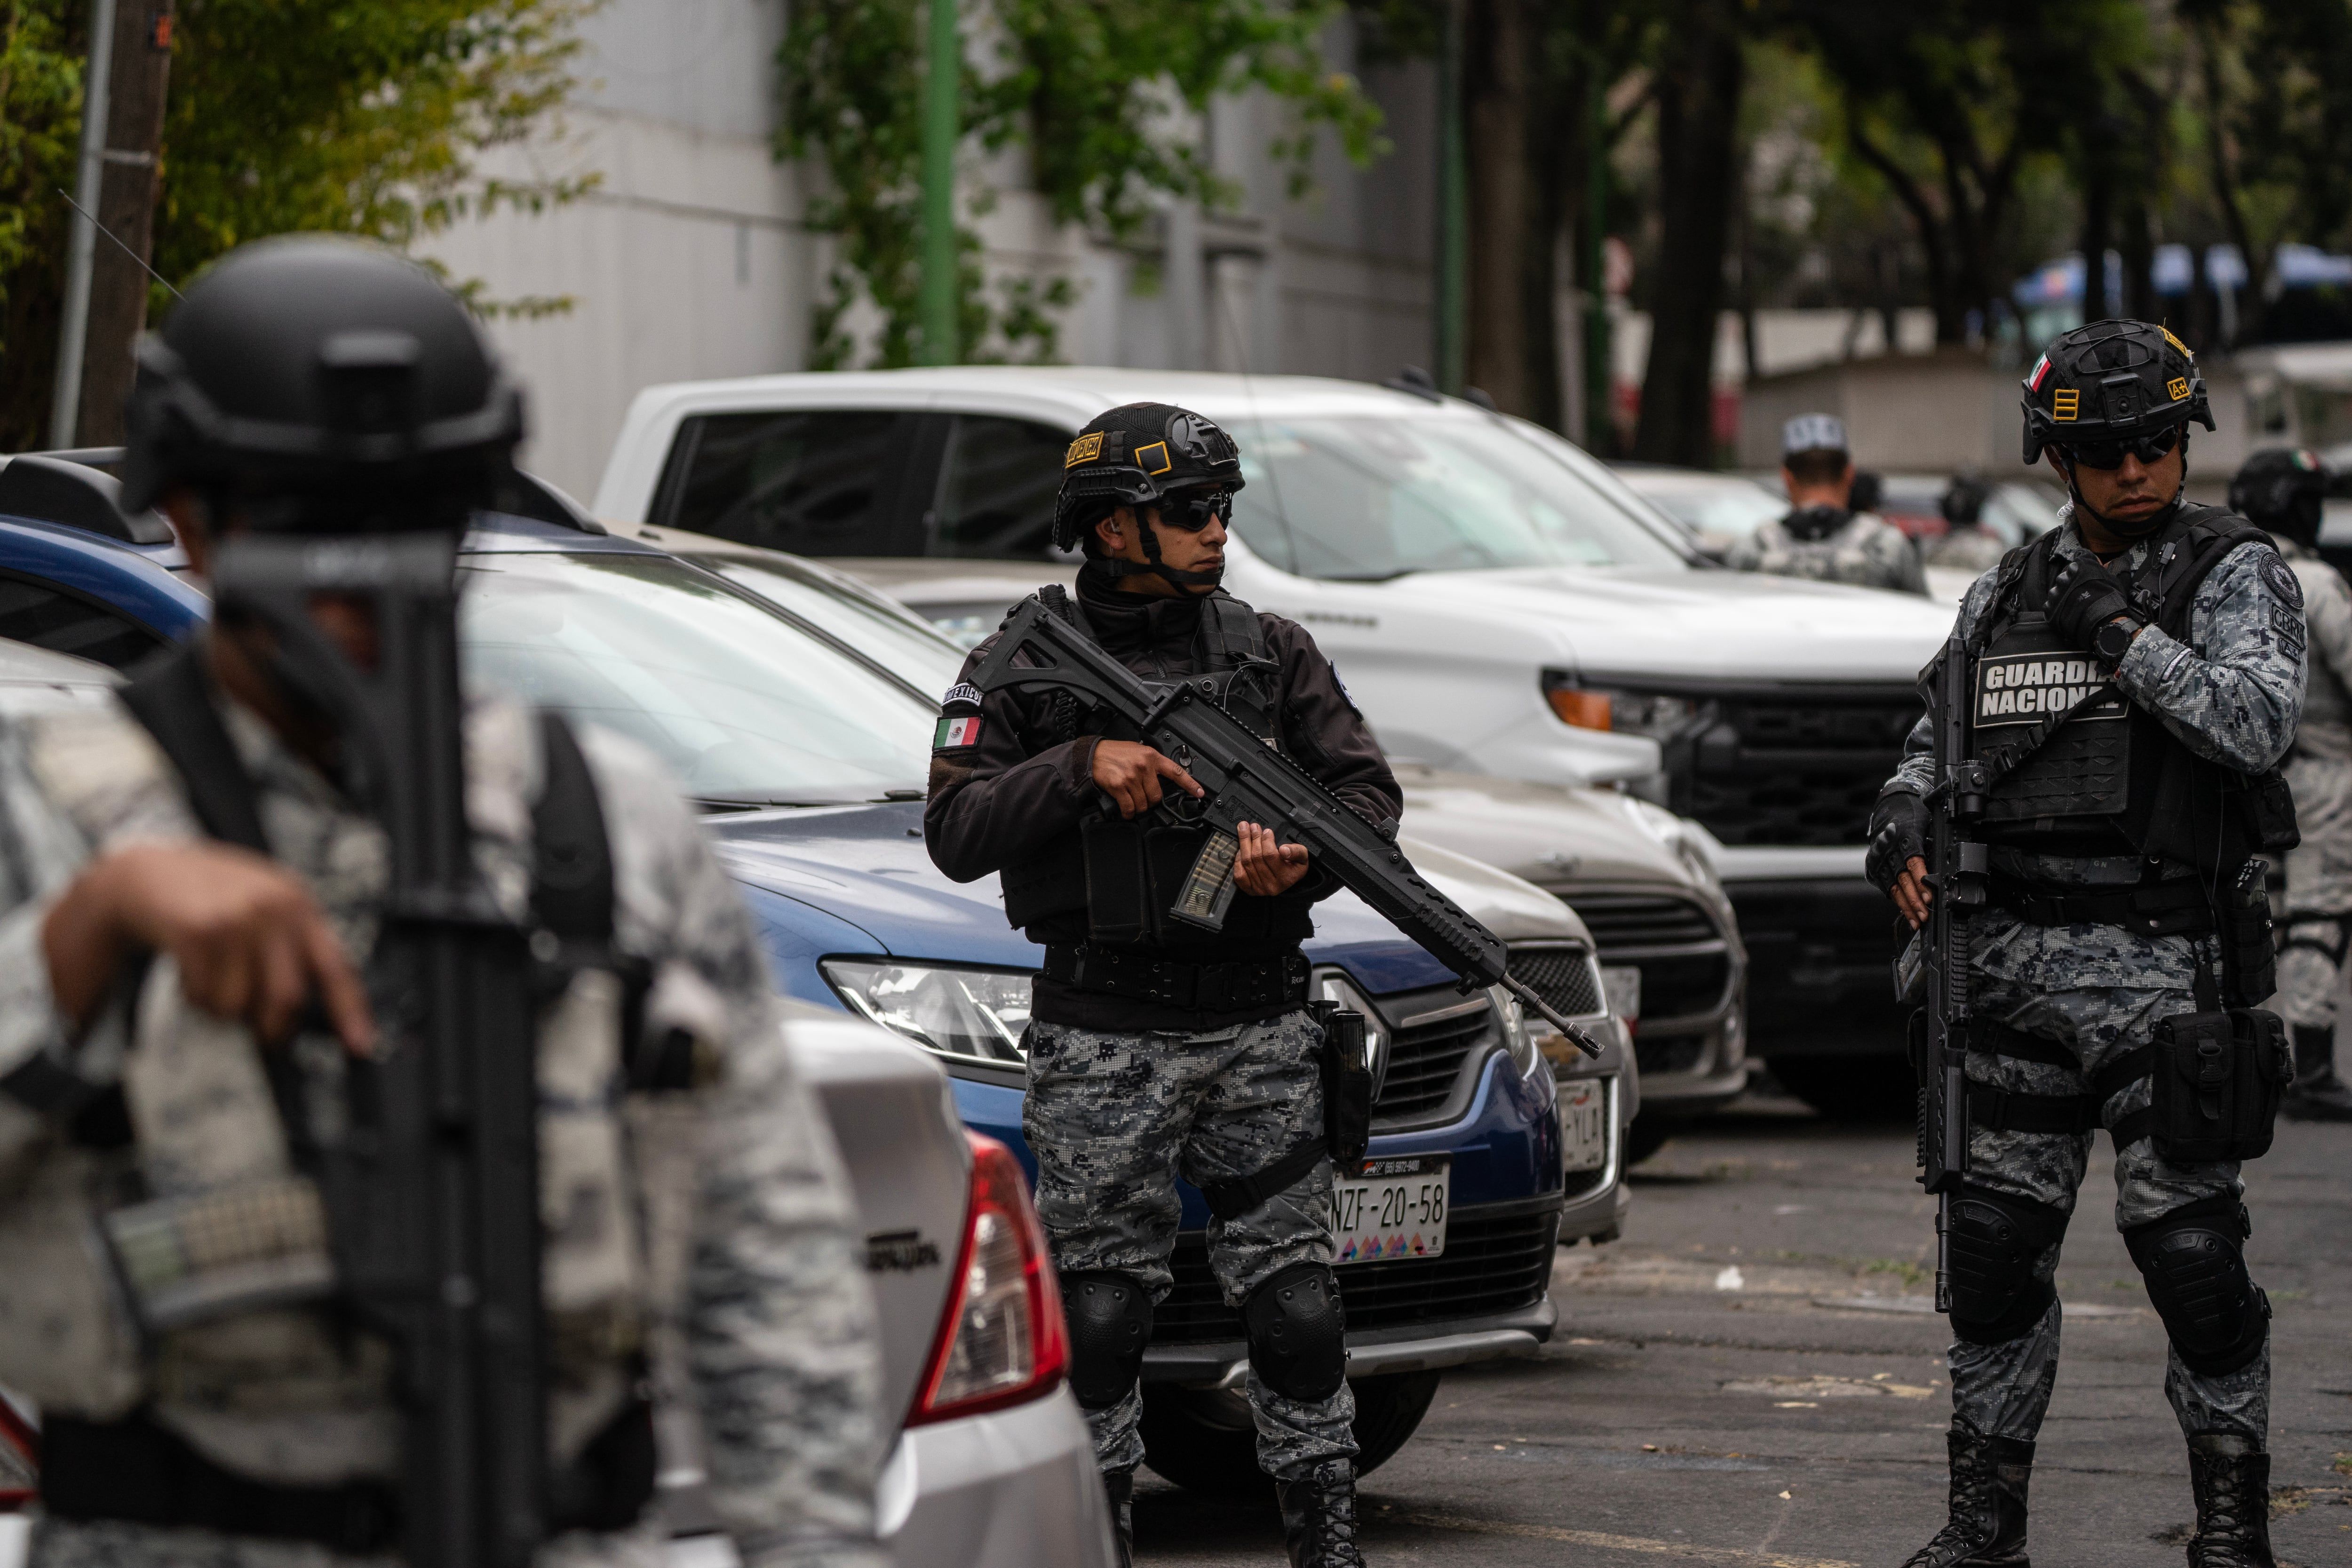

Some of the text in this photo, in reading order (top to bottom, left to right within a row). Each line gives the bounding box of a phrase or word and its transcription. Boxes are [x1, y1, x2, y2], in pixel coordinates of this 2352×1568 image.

[2173, 383, 2186, 397] A+
[2274, 609, 2303, 644] CBRN
[1330, 1184, 1444, 1232] NZF-20-58
